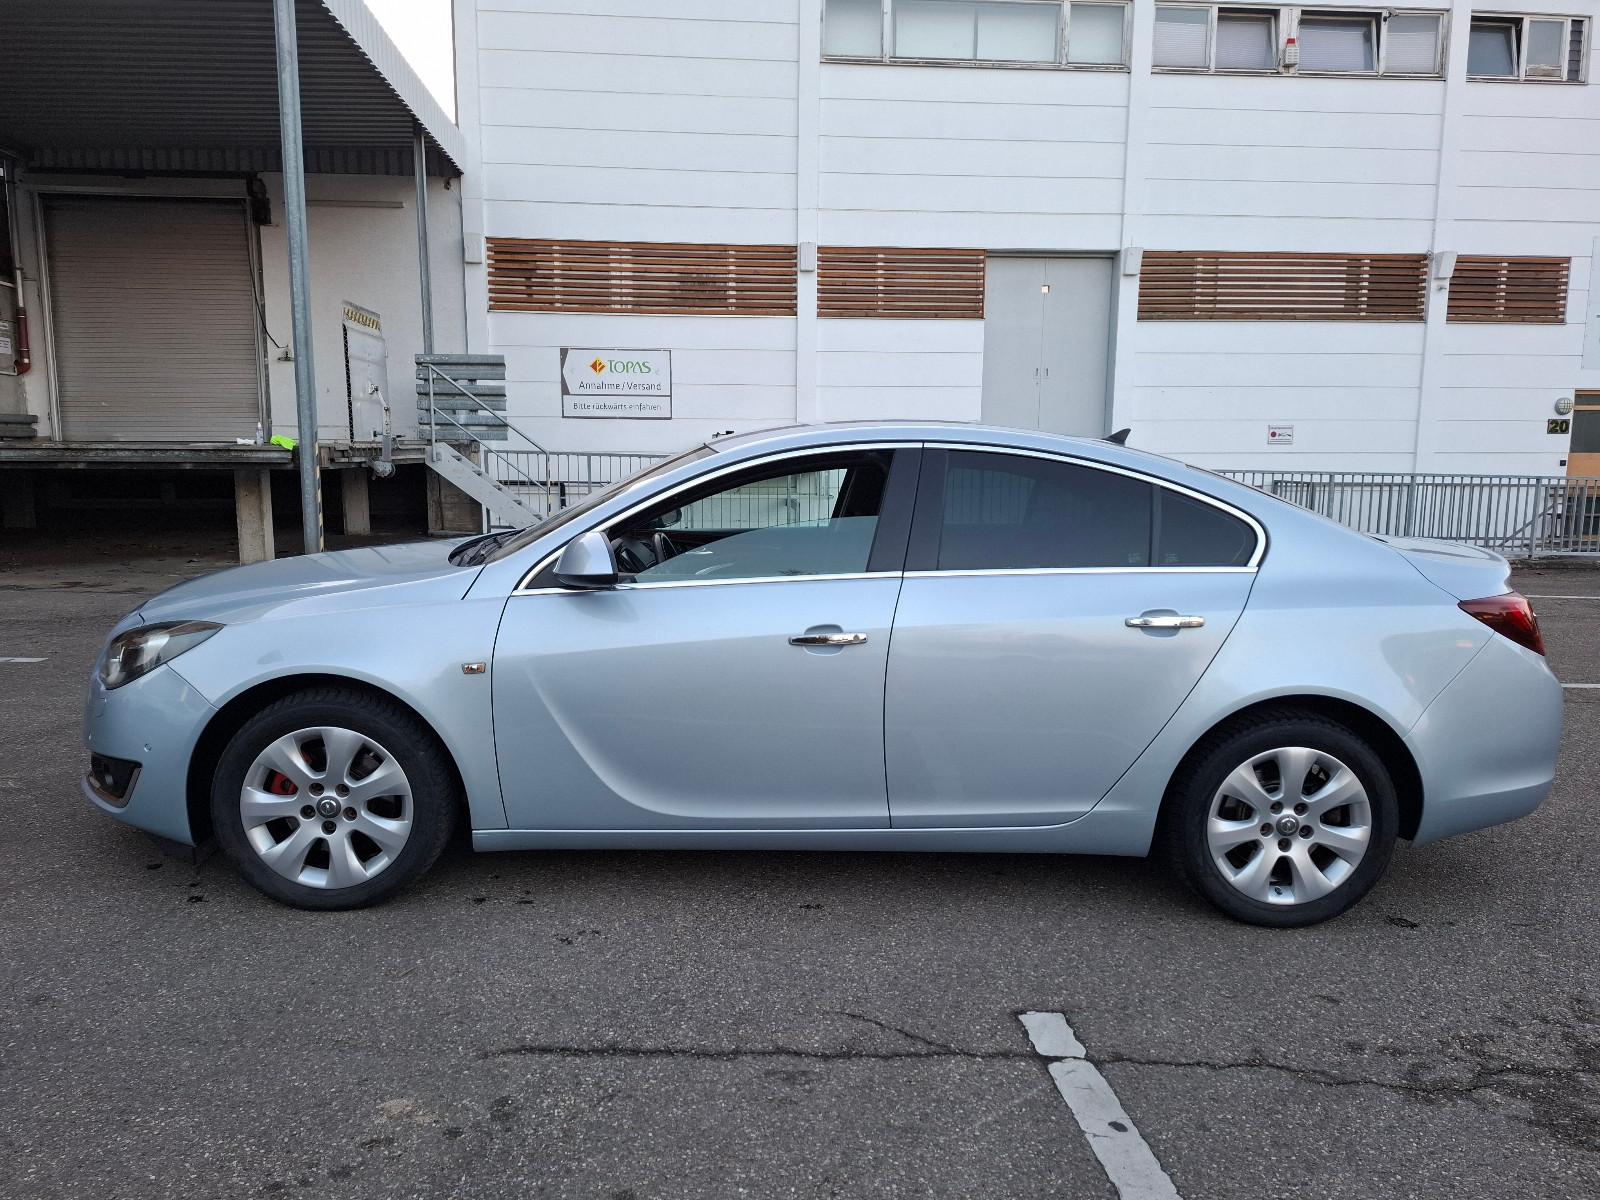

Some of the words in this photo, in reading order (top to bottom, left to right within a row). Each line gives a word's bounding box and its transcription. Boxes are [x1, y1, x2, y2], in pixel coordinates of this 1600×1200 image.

[608, 360, 652, 373] TOPAS
[592, 402, 627, 411] rückwärts
[1549, 420, 1569, 432] 20
